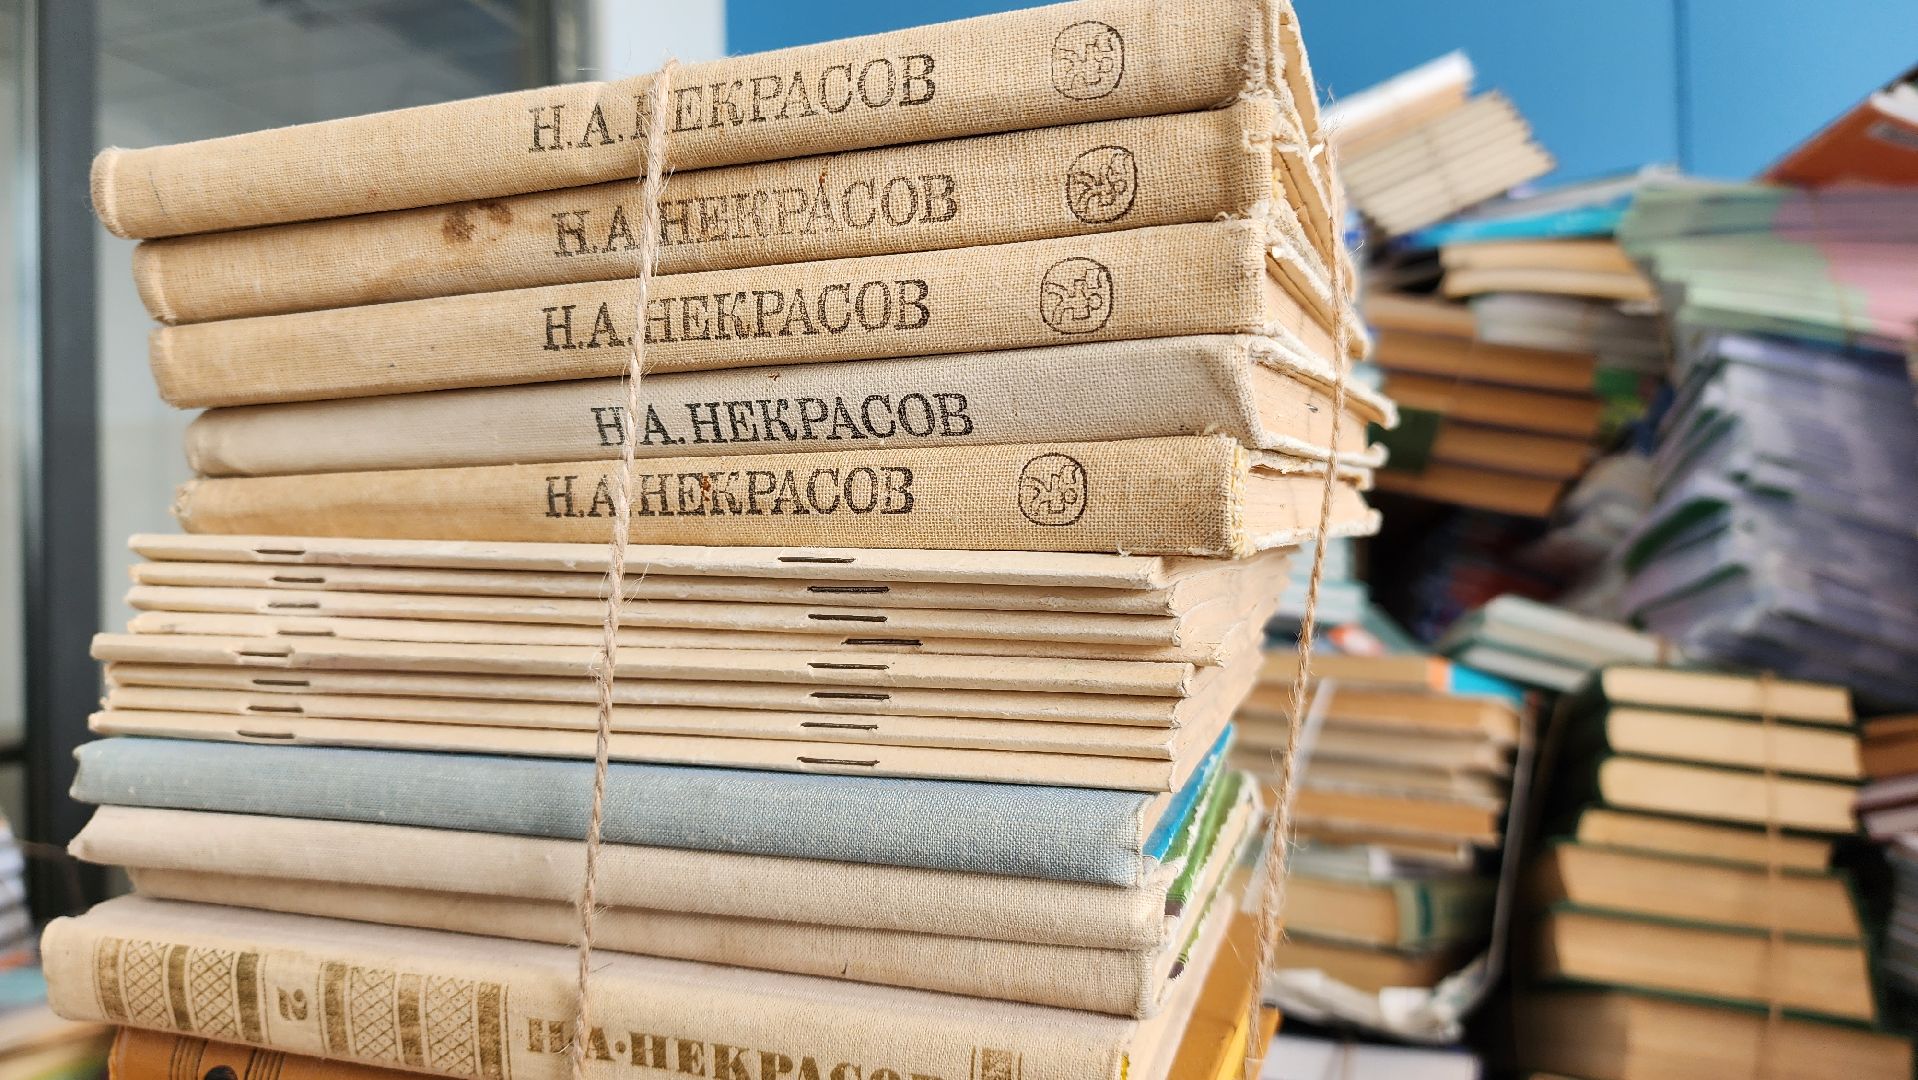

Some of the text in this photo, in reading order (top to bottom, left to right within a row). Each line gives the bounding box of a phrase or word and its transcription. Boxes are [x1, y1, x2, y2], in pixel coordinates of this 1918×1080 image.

[551, 174, 959, 258] Н.АНЕКРАСОВ
[590, 392, 974, 447] НА.НЕКРАСОВ
[545, 466, 915, 518] Н.АНЕКРАСОВ
[276, 985, 308, 1021] 2
